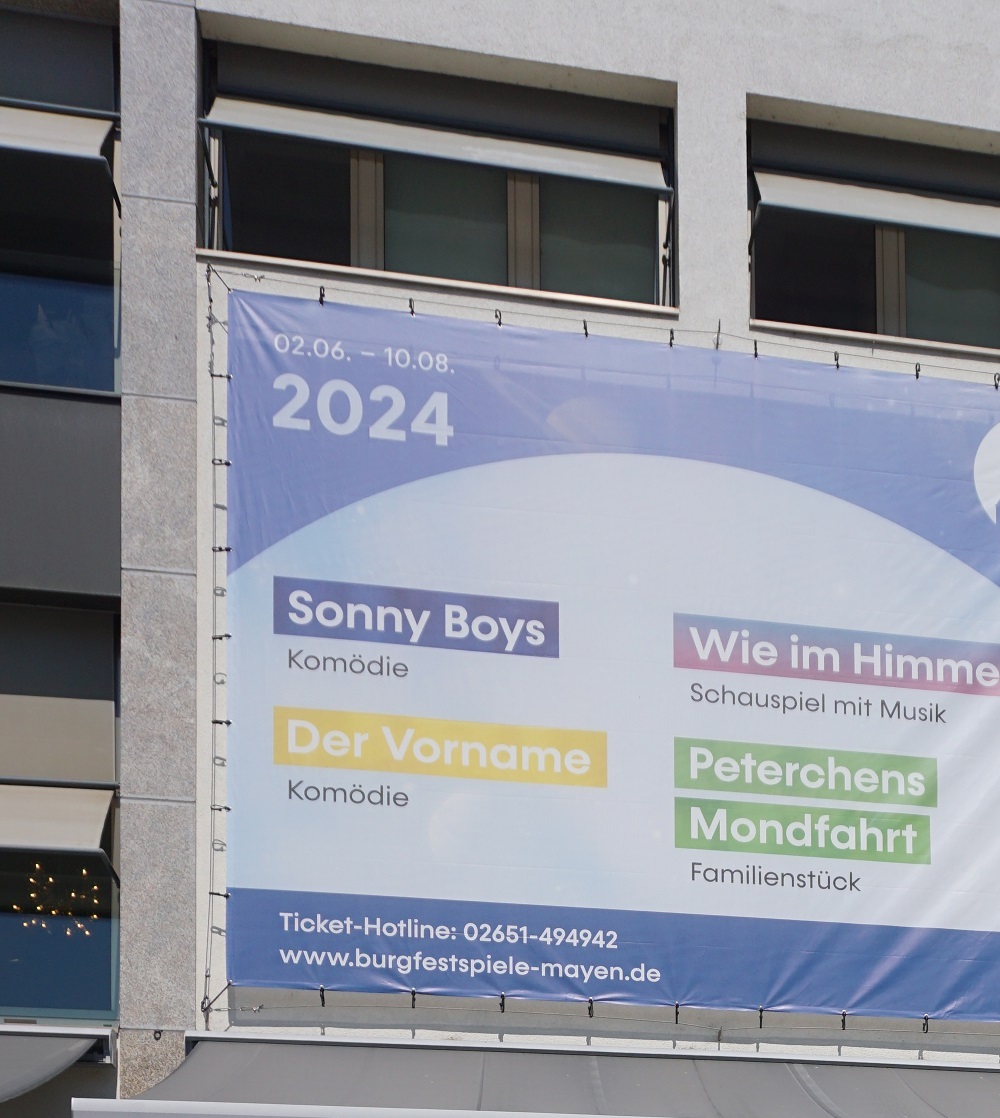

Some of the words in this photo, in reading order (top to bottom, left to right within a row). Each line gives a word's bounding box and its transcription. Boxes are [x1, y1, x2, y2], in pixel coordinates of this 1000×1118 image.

[274, 334, 351, 362] 02.06.
[384, 347, 455, 374] 10.08.
[272, 373, 454, 447] 2024
[287, 589, 431, 643] Sonny
[445, 603, 546, 652] Boys
[287, 648, 409, 679] Komödie
[689, 626, 778, 668] Wie
[790, 634, 840, 673] im
[690, 682, 826, 716] Schauspiel
[834, 695, 872, 718] mit
[880, 700, 947, 724] Musik
[287, 719, 367, 759] Der
[382, 726, 591, 775] Vorname
[689, 746, 926, 797] Peterchens
[287, 780, 409, 808] Komödie
[689, 806, 918, 855] Mondfahrt
[690, 861, 861, 892] Familienstück
[279, 912, 457, 940] Ticket-Hotline:
[463, 922, 618, 949] 02651-494942
[279, 948, 661, 983] www.burgfestspiele-mayen.de
